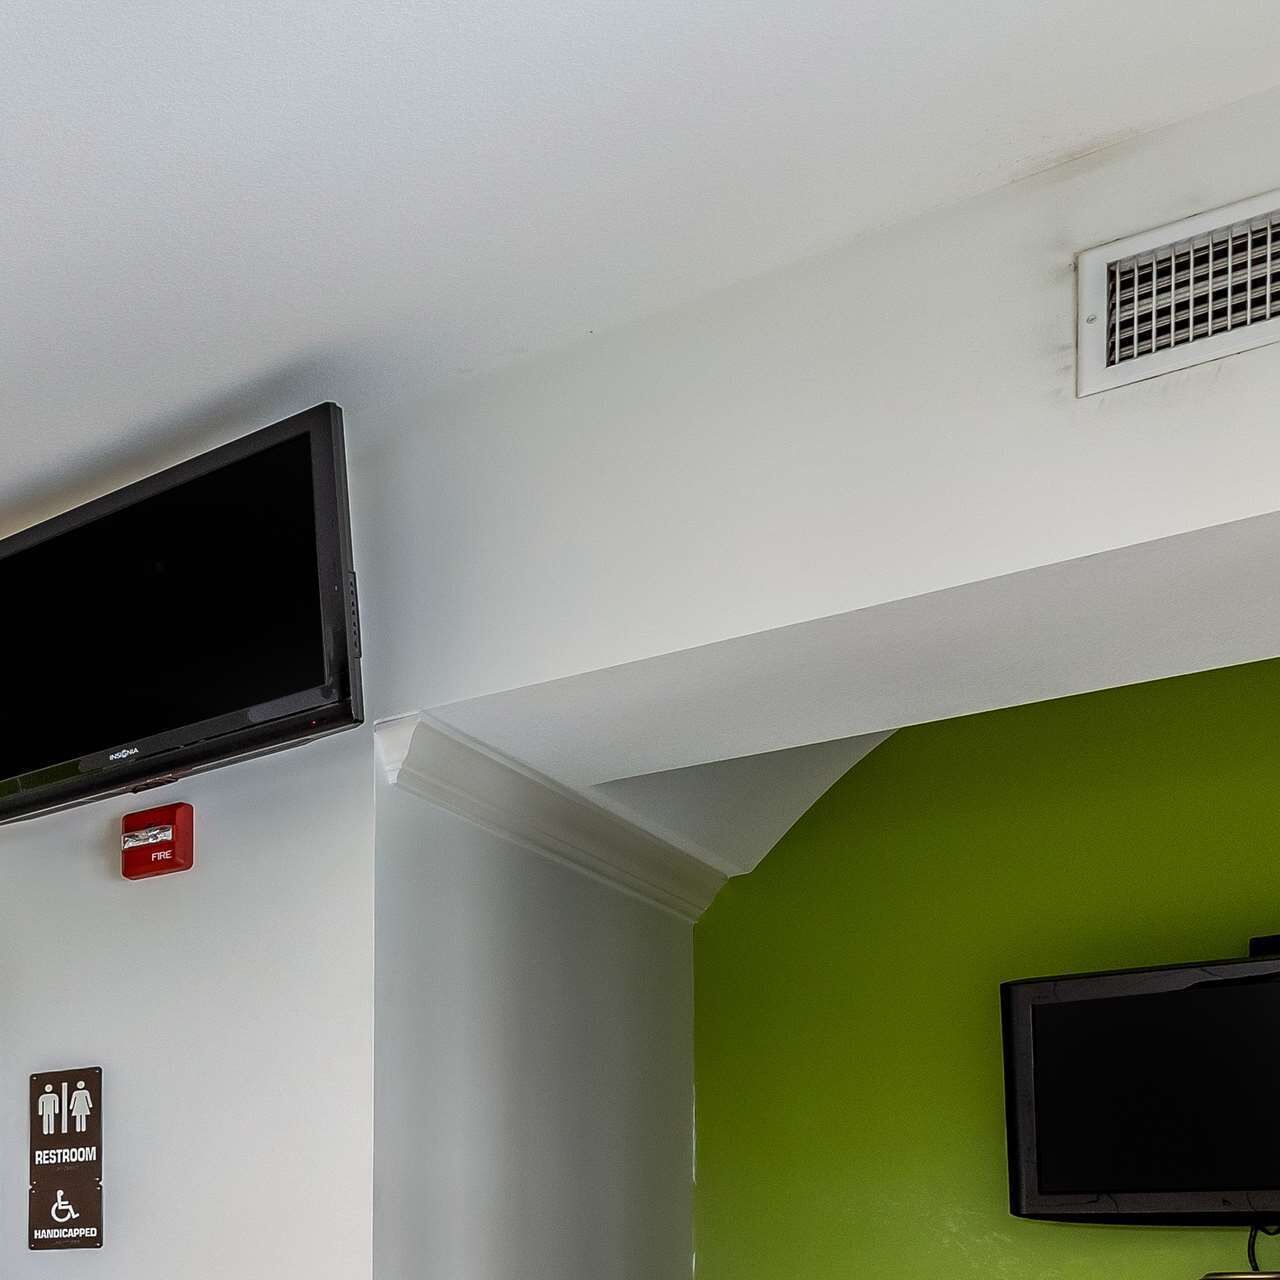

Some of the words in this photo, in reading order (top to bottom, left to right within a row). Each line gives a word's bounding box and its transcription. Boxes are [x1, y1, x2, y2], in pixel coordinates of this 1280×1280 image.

[109, 747, 139, 760] INSIGNIA
[151, 850, 172, 861] FIRE
[35, 1147, 97, 1165] RESTROOM
[34, 1227, 97, 1239] HANDICAPPED
